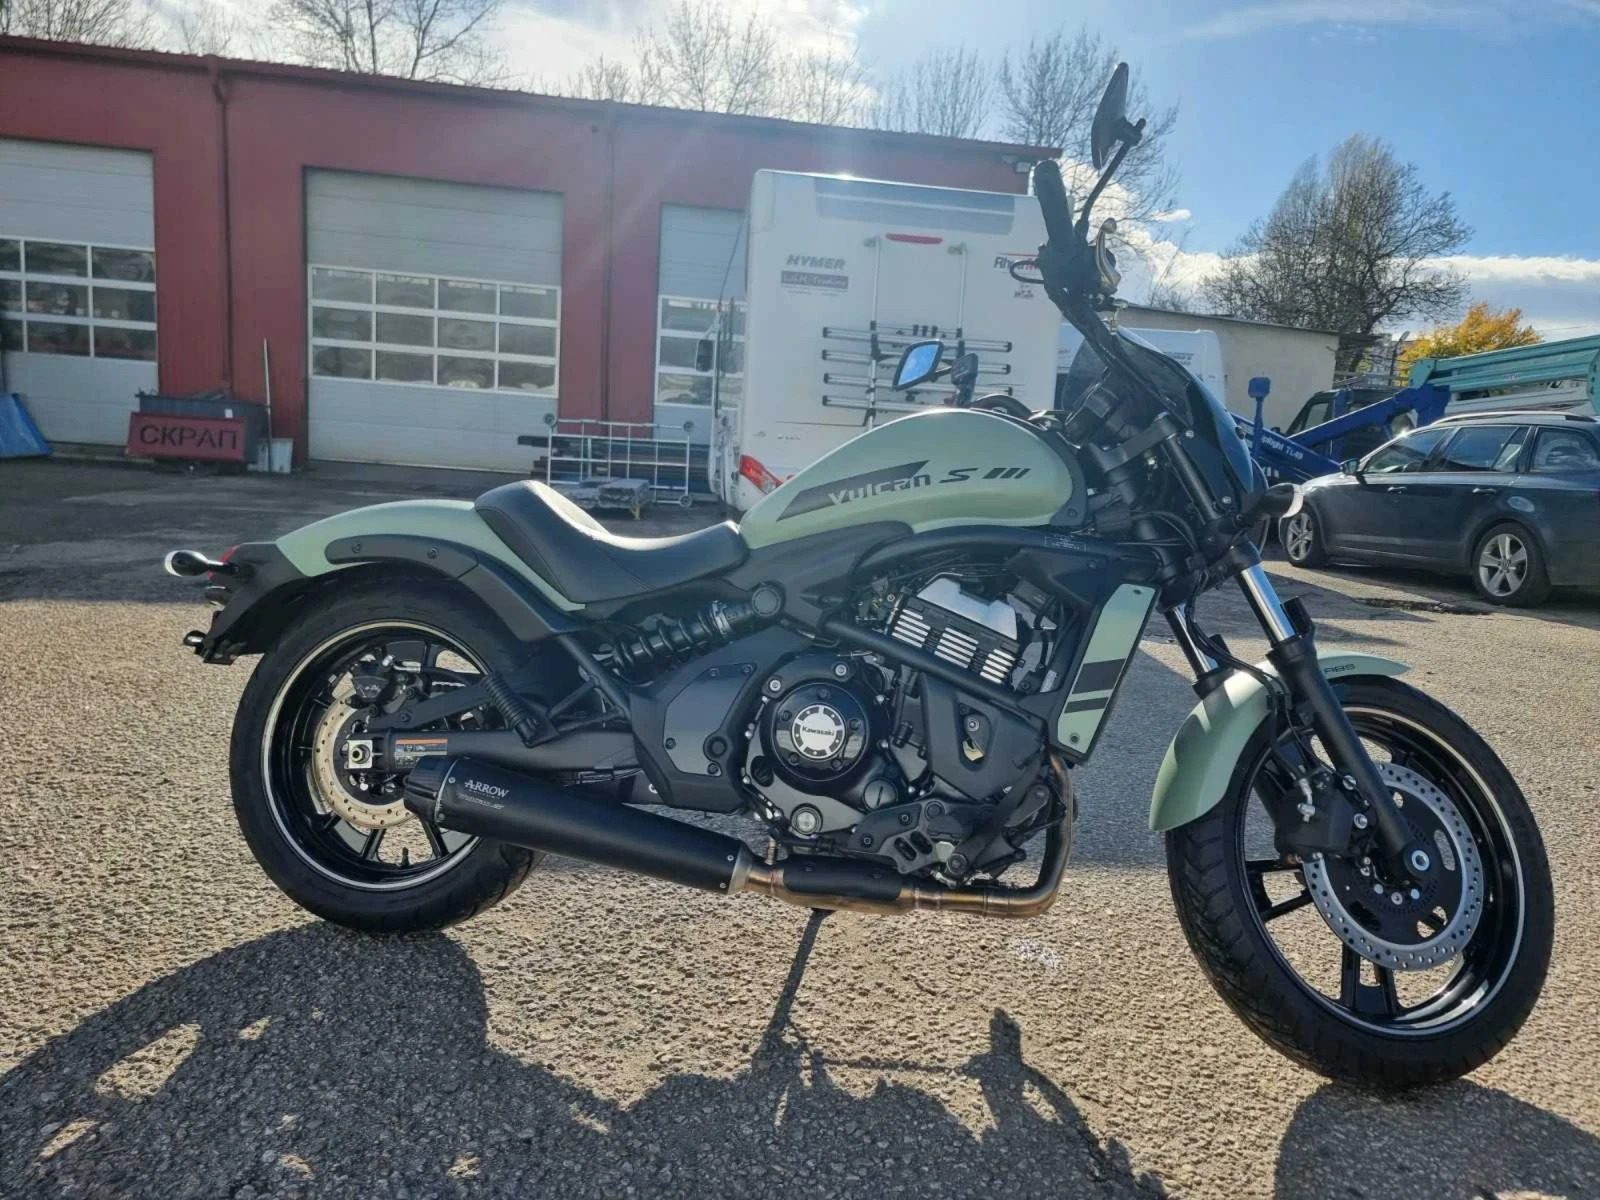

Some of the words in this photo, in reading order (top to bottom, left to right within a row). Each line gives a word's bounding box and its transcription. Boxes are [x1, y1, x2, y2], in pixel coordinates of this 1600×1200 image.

[786, 254, 845, 270] HYMER
[140, 424, 237, 450] СКРАП
[939, 467, 979, 484] S
[1324, 663, 1356, 673] ABS
[802, 726, 835, 737] Kawasaki
[464, 779, 510, 799] ARROW
